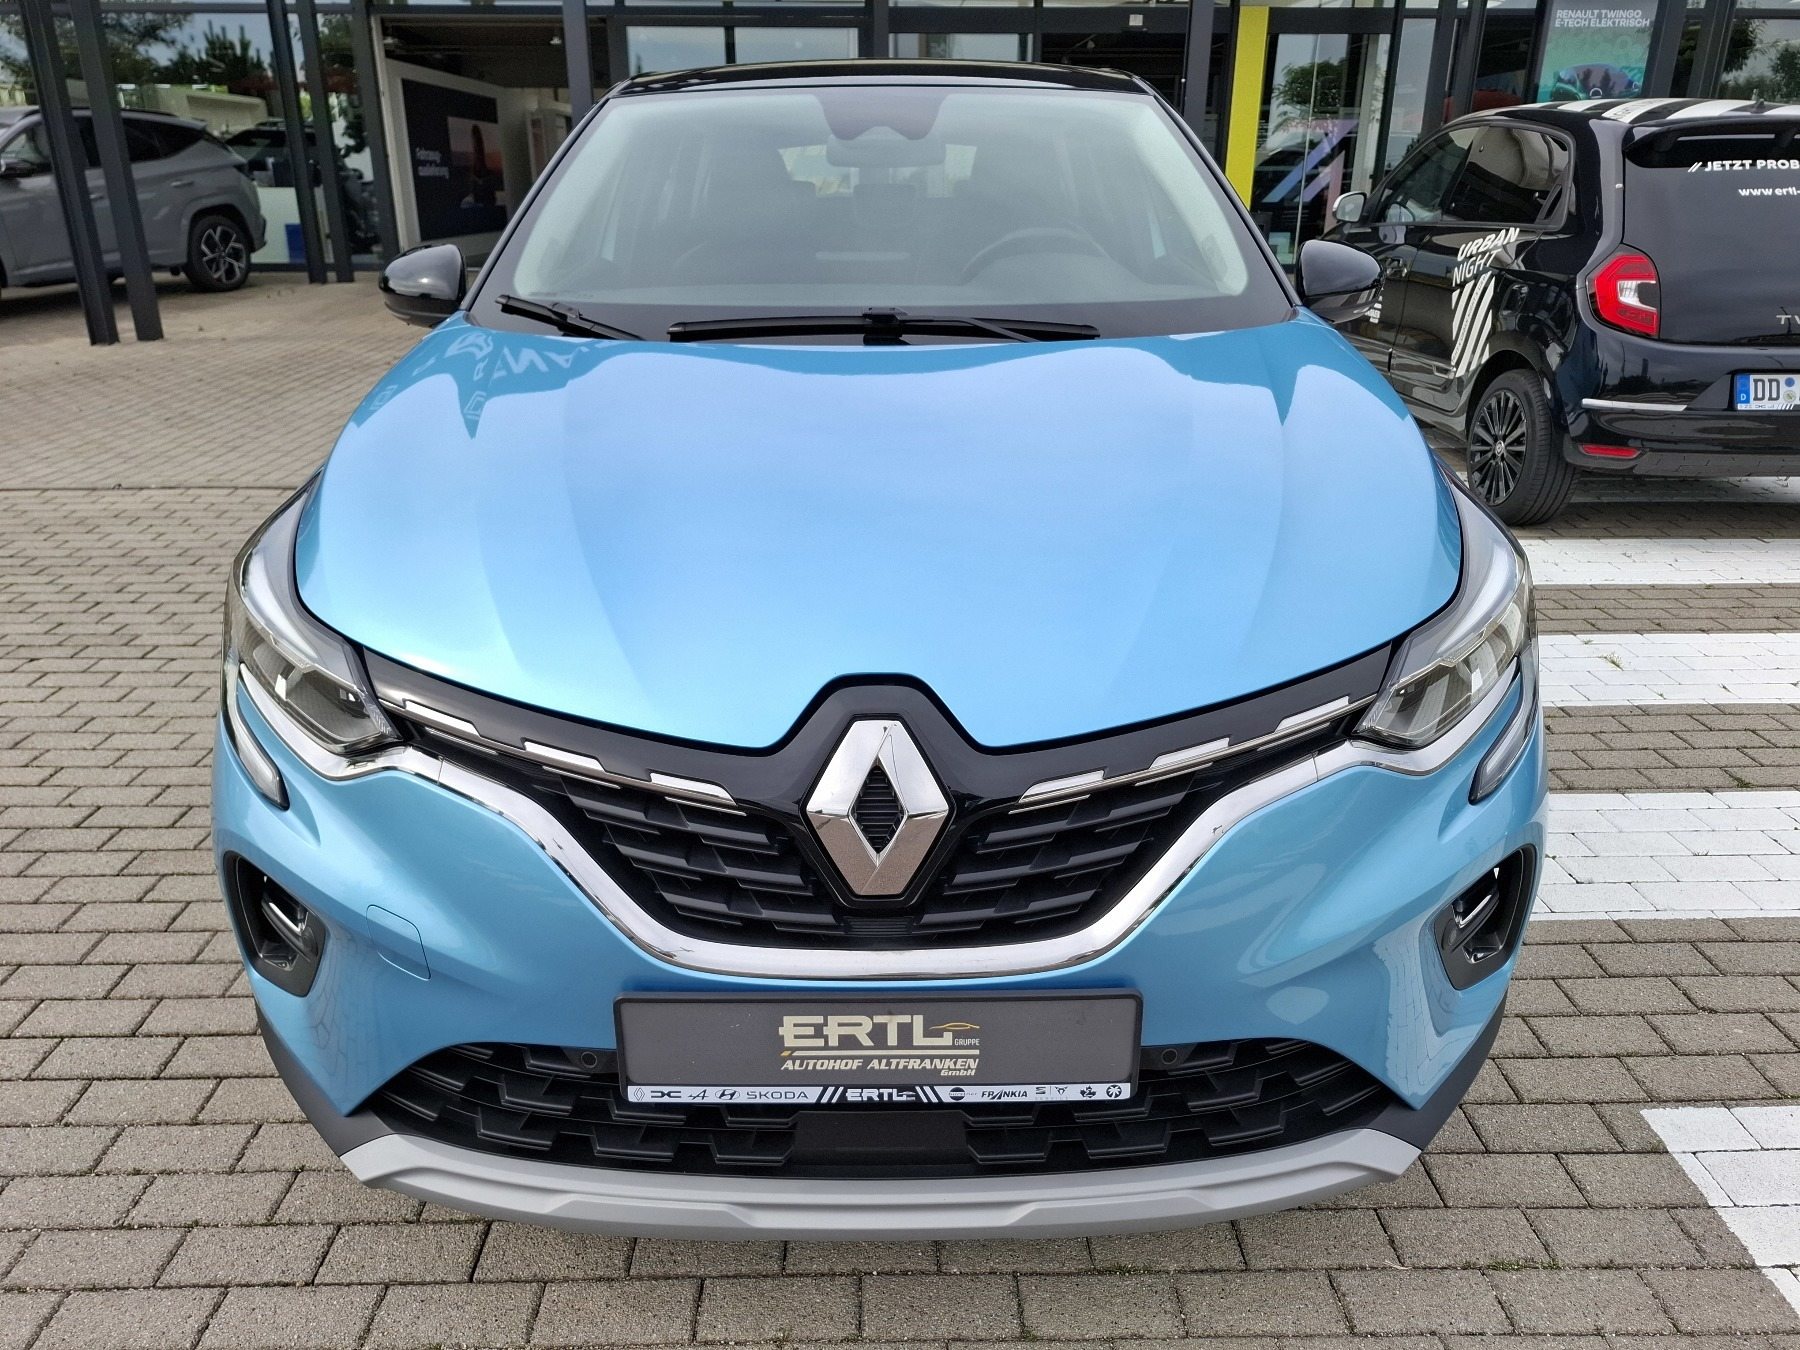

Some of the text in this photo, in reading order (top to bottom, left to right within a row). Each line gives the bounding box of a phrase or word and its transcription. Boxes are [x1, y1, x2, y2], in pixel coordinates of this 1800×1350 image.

[1556, 9, 1642, 19] RENAULT TWINGO
[1555, 18, 1650, 27] E-TECH ELEKTRISCH
[1704, 159, 1800, 172] JETZT PROB
[1457, 227, 1520, 261] URBAN
[1452, 250, 1498, 287] NIGHT
[1740, 378, 1780, 402] D DD
[779, 1014, 980, 1047] ERTL GRUPPE
[780, 1058, 980, 1071] AUTOHOF ALTFRANKEN
[940, 1069, 976, 1077] GmbH
[845, 1088, 907, 1101] ERTL
